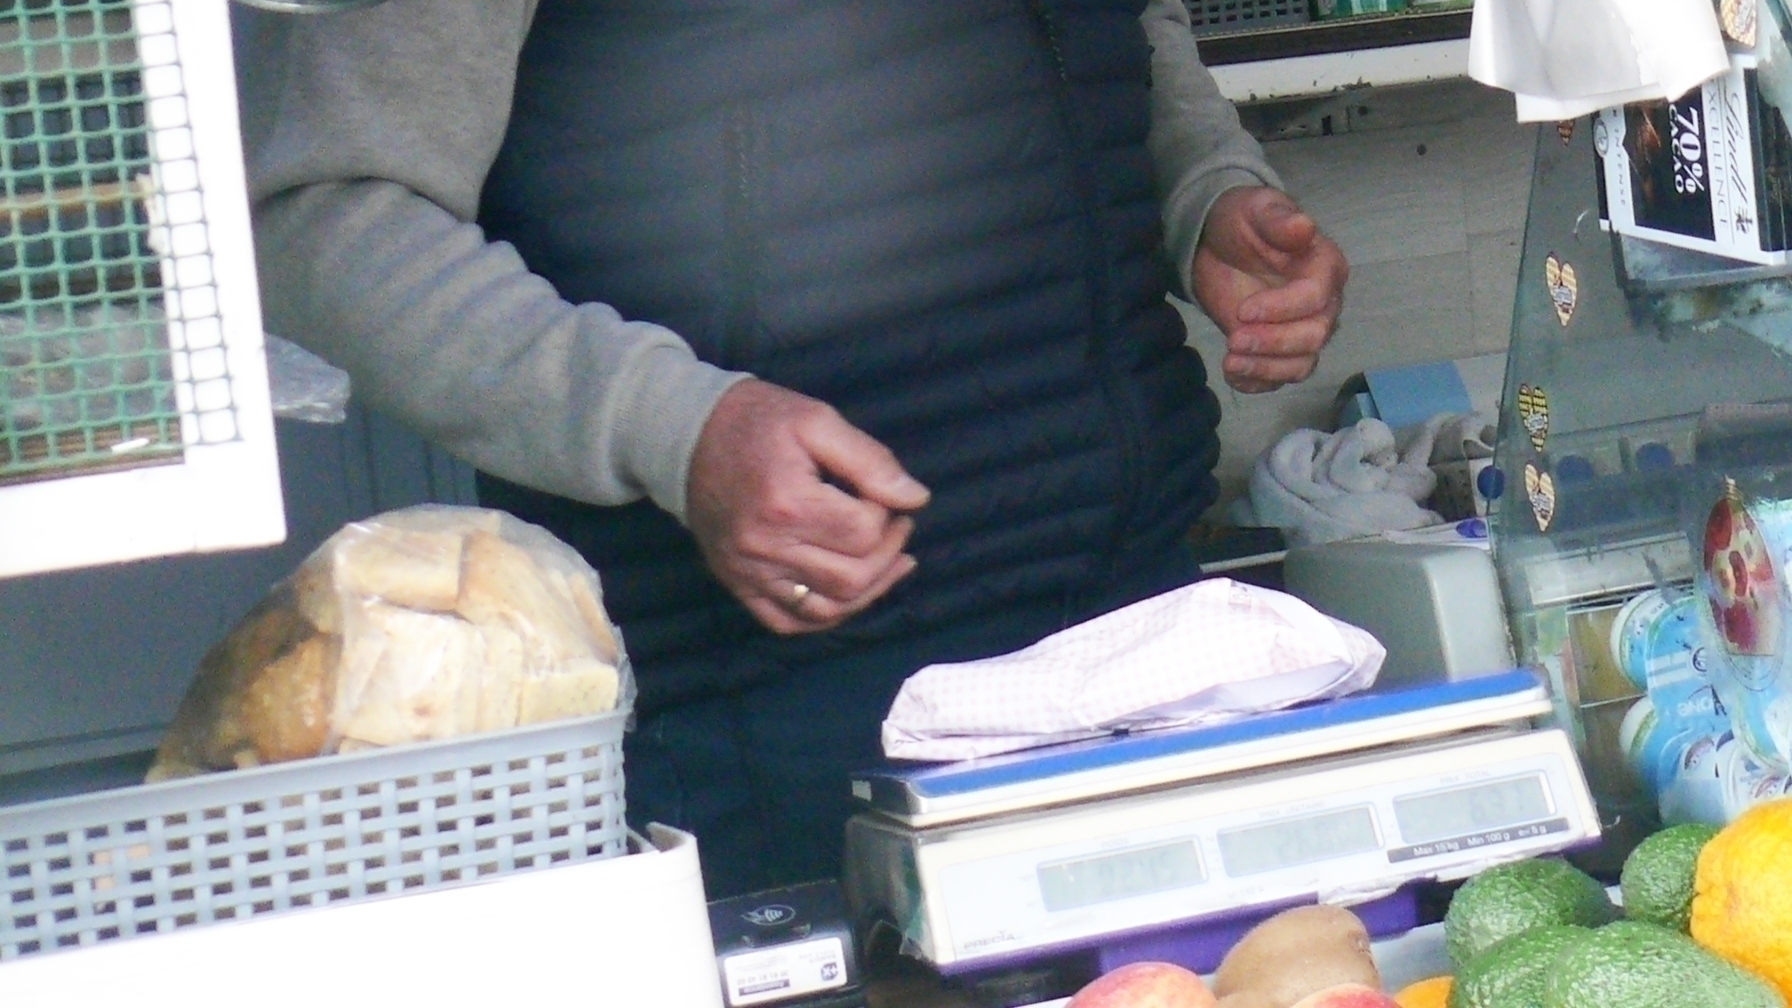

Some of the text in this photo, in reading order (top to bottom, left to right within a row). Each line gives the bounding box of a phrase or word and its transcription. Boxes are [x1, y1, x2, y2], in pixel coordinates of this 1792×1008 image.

[1668, 104, 1685, 194] CACAO
[1677, 106, 1705, 193] 70%
[1706, 80, 1729, 231] XCELLENCE
[1413, 846, 1433, 856] Max
[1467, 835, 1484, 847] Min
[1485, 833, 1501, 843] 100
